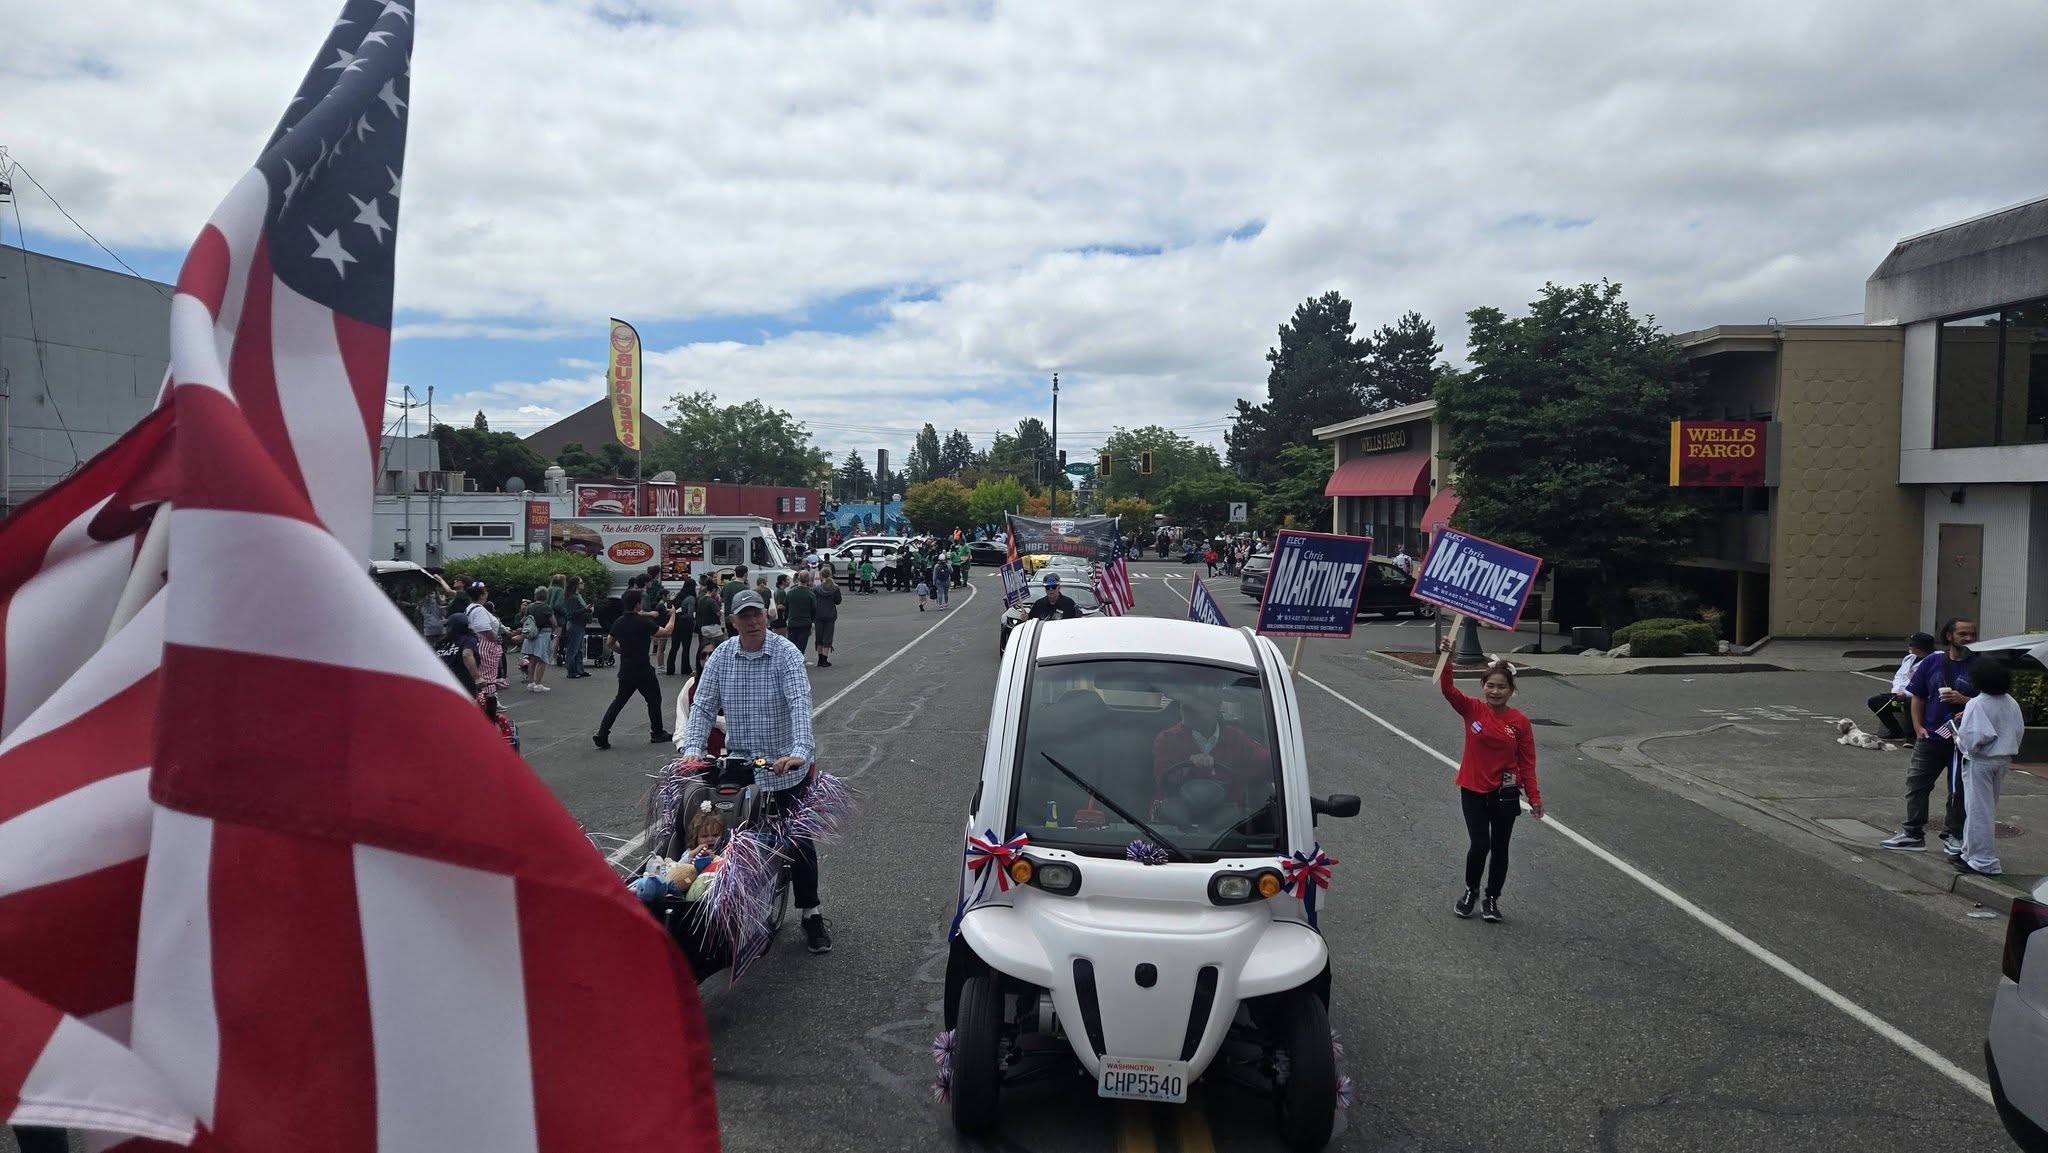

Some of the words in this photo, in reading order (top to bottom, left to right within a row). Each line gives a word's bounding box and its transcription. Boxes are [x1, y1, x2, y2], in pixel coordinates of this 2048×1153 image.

[1687, 428, 1756, 442] WELLS
[1360, 434, 1382, 452] WELLS
[1382, 430, 1406, 450] FARGO
[1688, 444, 1755, 458] FARGO
[532, 505, 548, 514] WELLS
[532, 515, 548, 525] FARGO
[601, 524, 613, 533] The
[616, 524, 631, 533] best
[633, 524, 666, 533] BURGER
[1286, 536, 1306, 545] ELECT
[1445, 532, 1466, 542] ELECT
[616, 548, 645, 556] BURGERS
[1025, 543, 1048, 552] NBFC
[1463, 546, 1485, 559] Chris
[1304, 550, 1324, 560] Chris
[1268, 547, 1362, 608] MARTINEZ
[1424, 538, 1529, 607] MARTINEZ
[1422, 590, 1451, 602] WASHINGTON
[1468, 599, 1488, 609] CHANGE
[436, 646, 459, 657] STAFF
[1107, 1063, 1154, 1072] WASHINGTON
[1104, 1072, 1181, 1096] CHP5540
